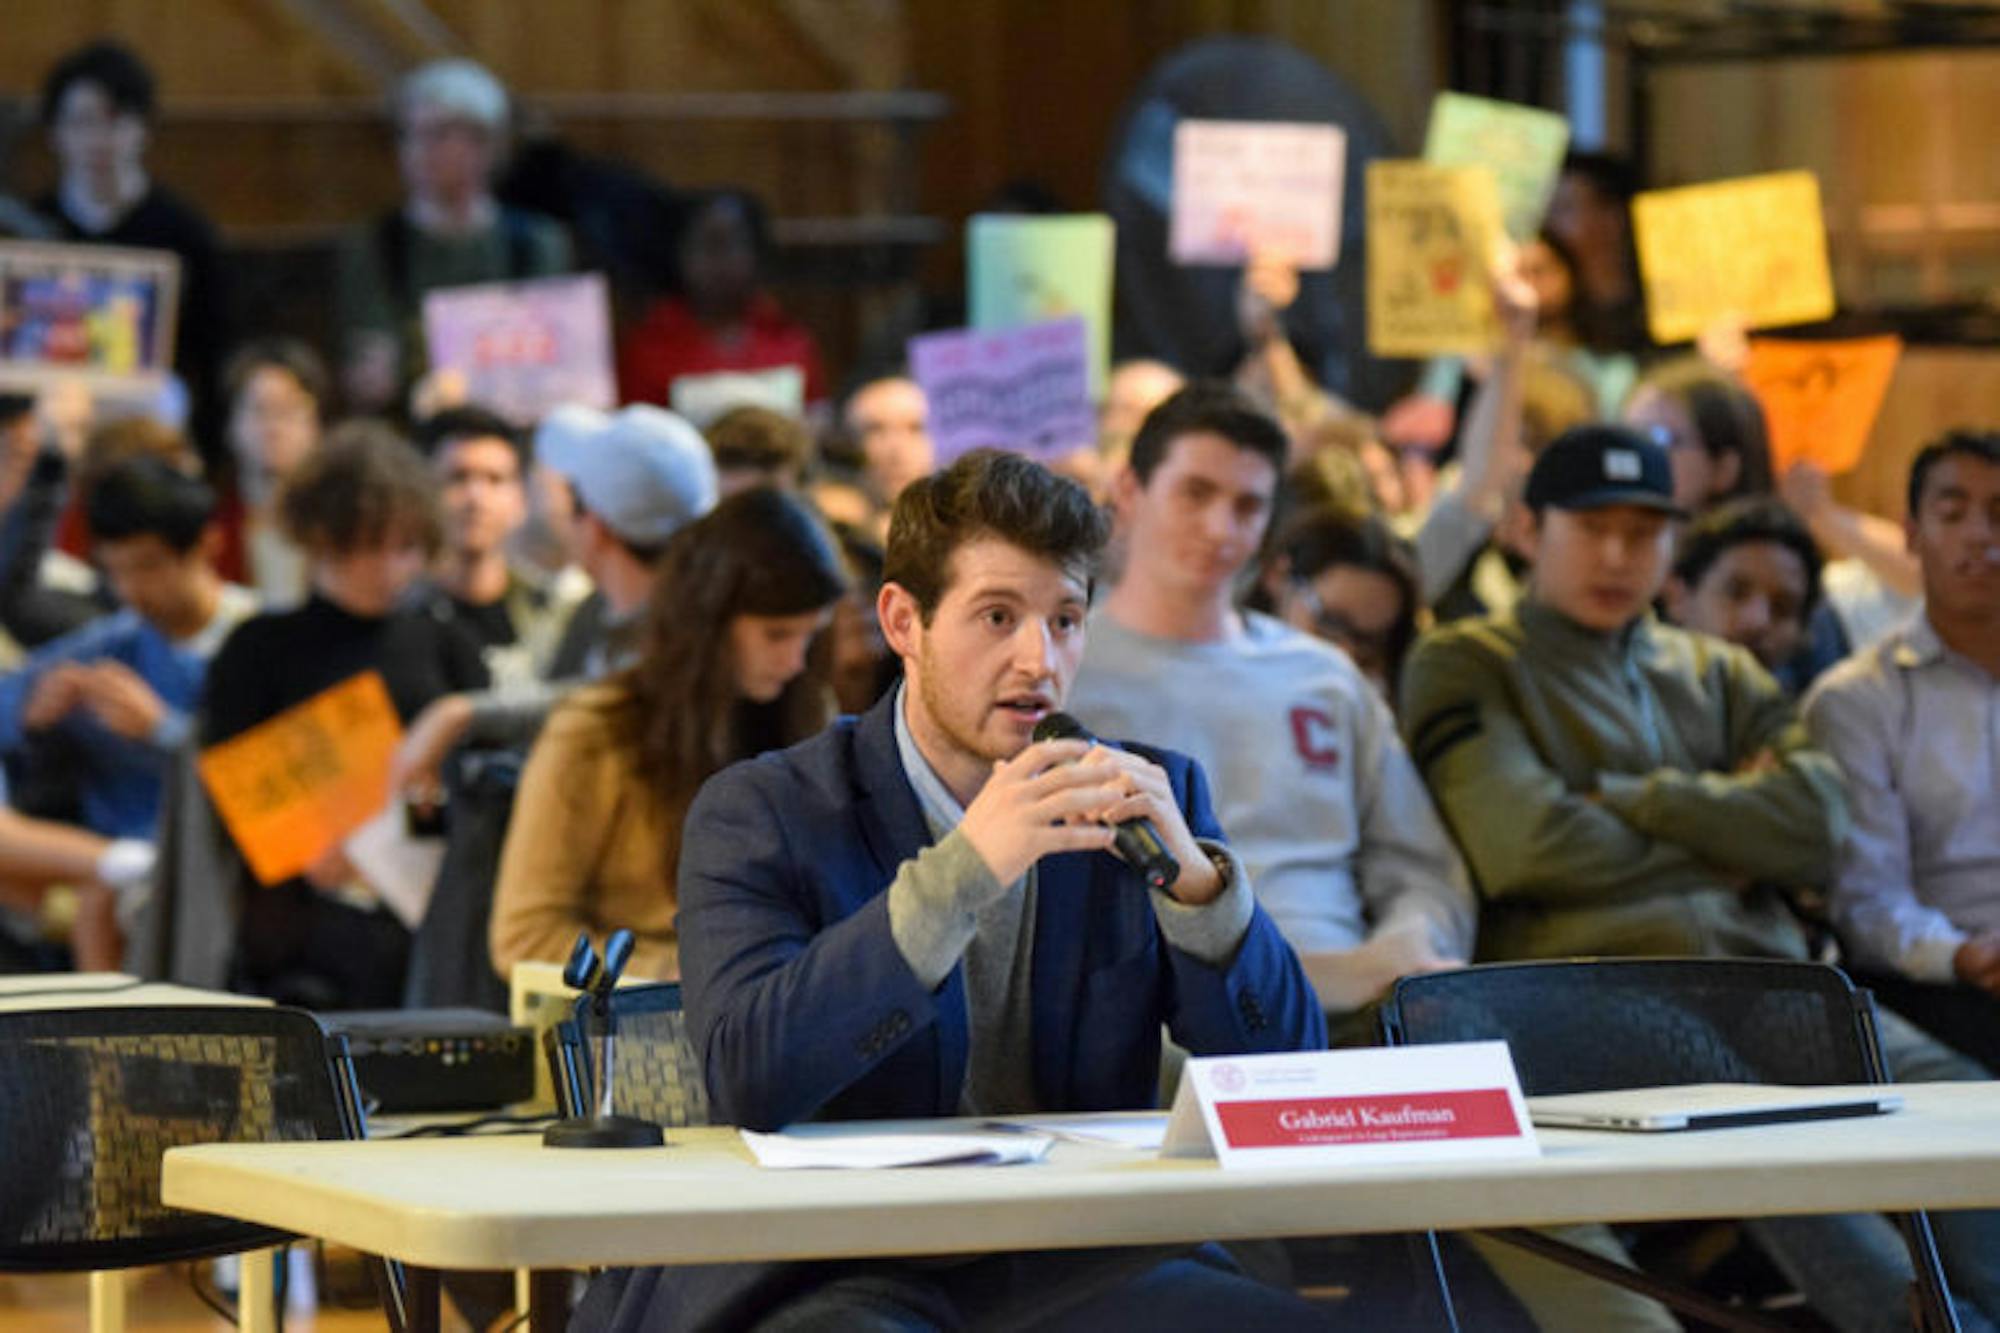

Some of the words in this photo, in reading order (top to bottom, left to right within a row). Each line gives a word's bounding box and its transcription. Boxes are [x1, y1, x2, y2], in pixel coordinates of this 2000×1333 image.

[1289, 706, 1339, 770] C
[1279, 1108, 1356, 1130] Gabriel
[1358, 1104, 1456, 1127] Kaufman
